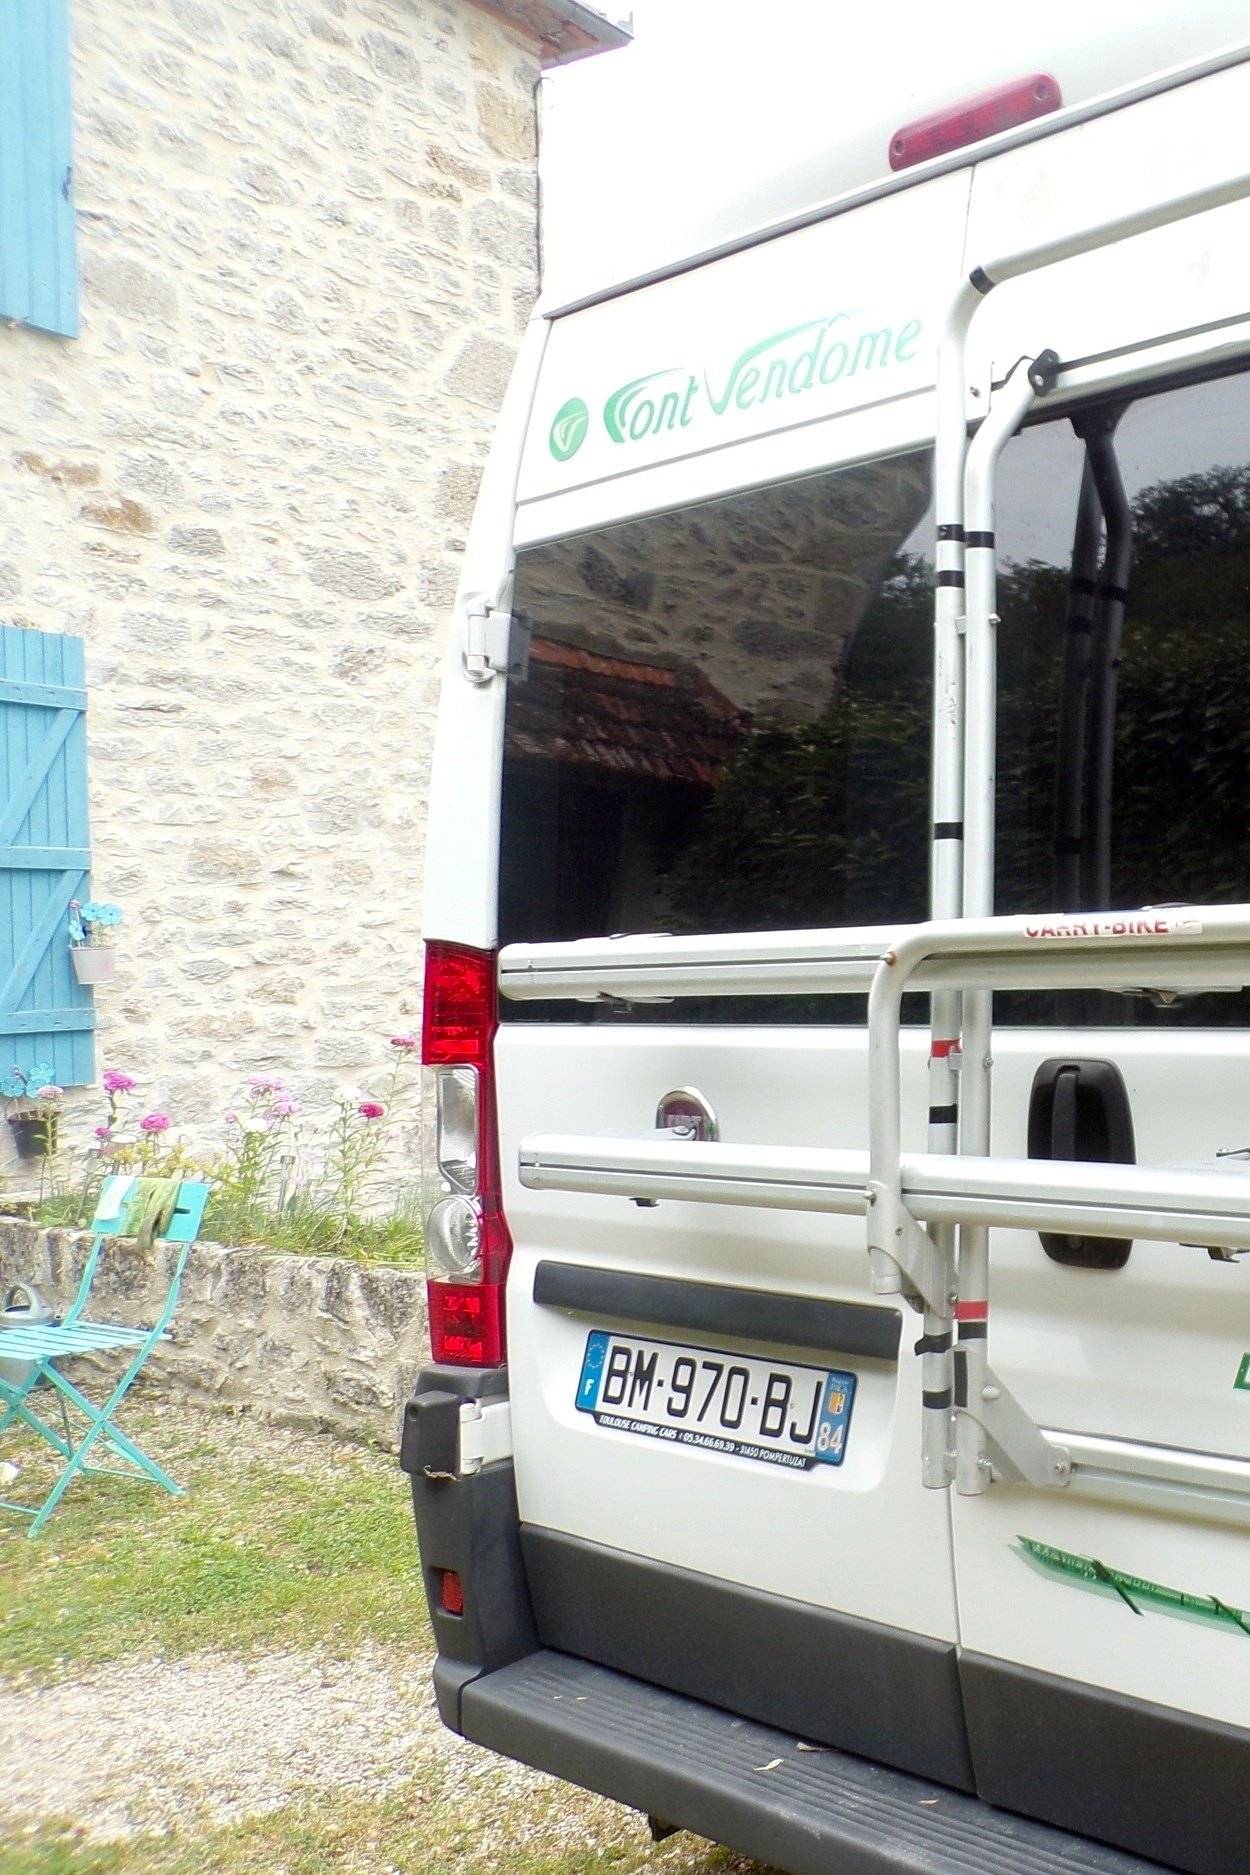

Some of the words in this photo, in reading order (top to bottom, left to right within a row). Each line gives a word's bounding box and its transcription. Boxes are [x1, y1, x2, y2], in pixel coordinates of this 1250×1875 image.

[584, 1379, 594, 1397] F
[600, 1415, 631, 1430] TOULOUSE
[631, 1421, 658, 1436] CAMPING
[660, 1427, 677, 1440] CARS
[817, 1421, 845, 1454] 84
